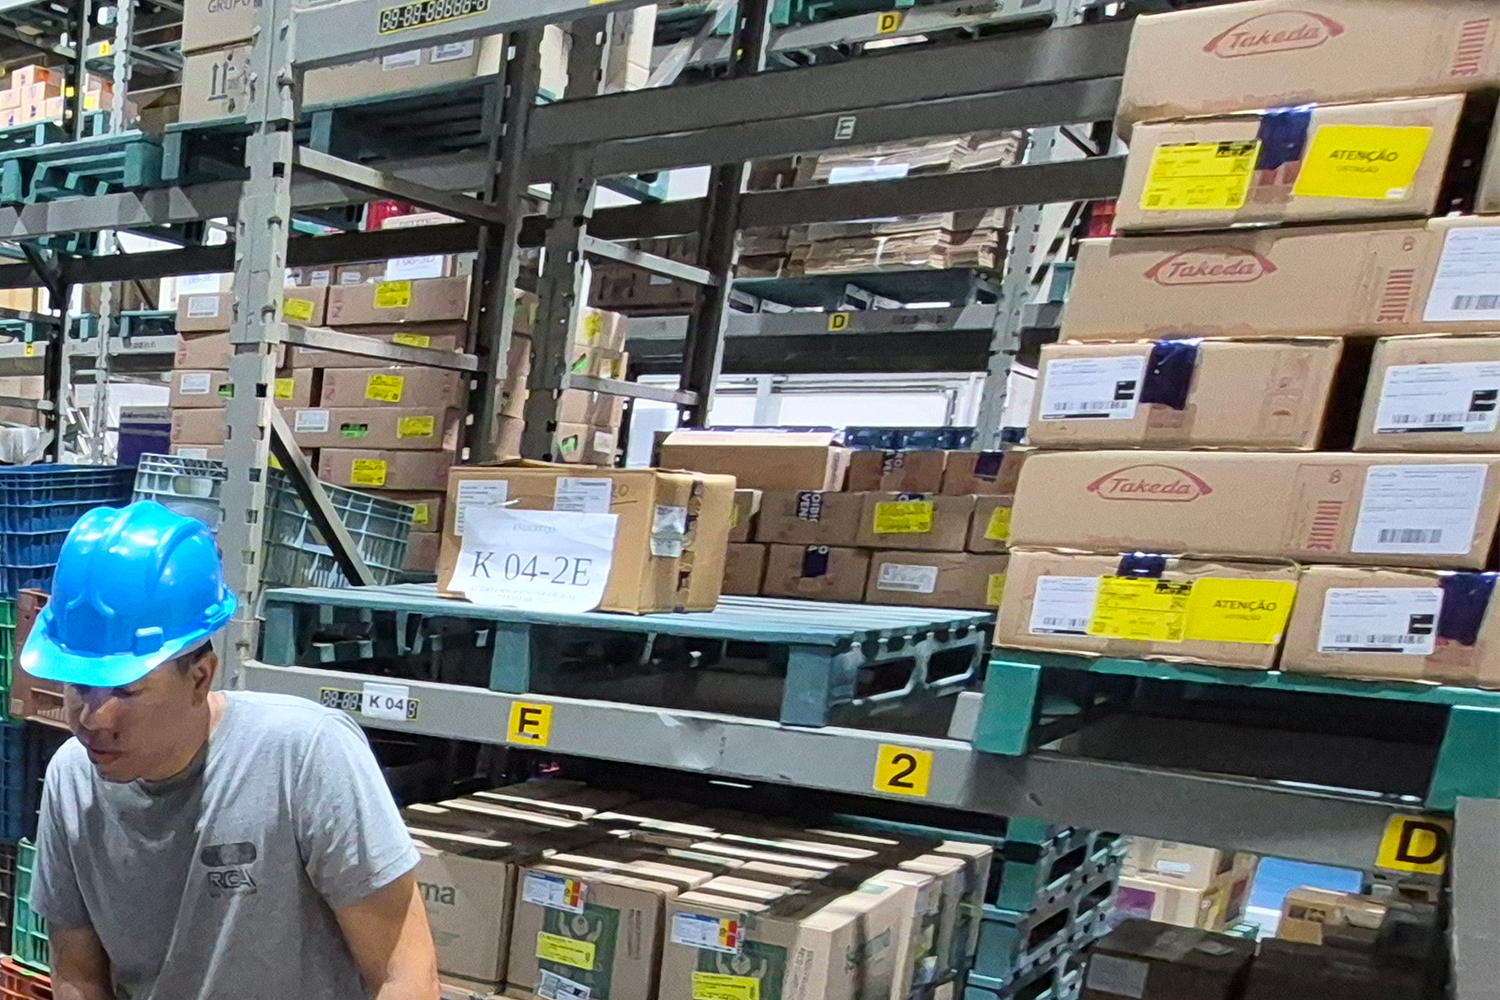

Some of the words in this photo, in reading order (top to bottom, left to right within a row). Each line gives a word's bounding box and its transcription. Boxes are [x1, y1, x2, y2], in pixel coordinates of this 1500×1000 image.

[881, 14, 896, 30] D
[1230, 23, 1320, 49] Takeda
[1329, 148, 1400, 163] ATENÇÃO
[1170, 261, 1256, 277] Takeda
[831, 314, 846, 329] D
[1109, 478, 1194, 496] Takeda
[470, 551, 495, 579] K
[504, 552, 593, 587] 04-2E
[1213, 599, 1277, 613] ATENÇÃO
[369, 695, 381, 709] K
[385, 696, 404, 711] 04
[887, 753, 918, 789] 2
[1395, 820, 1448, 865] D
